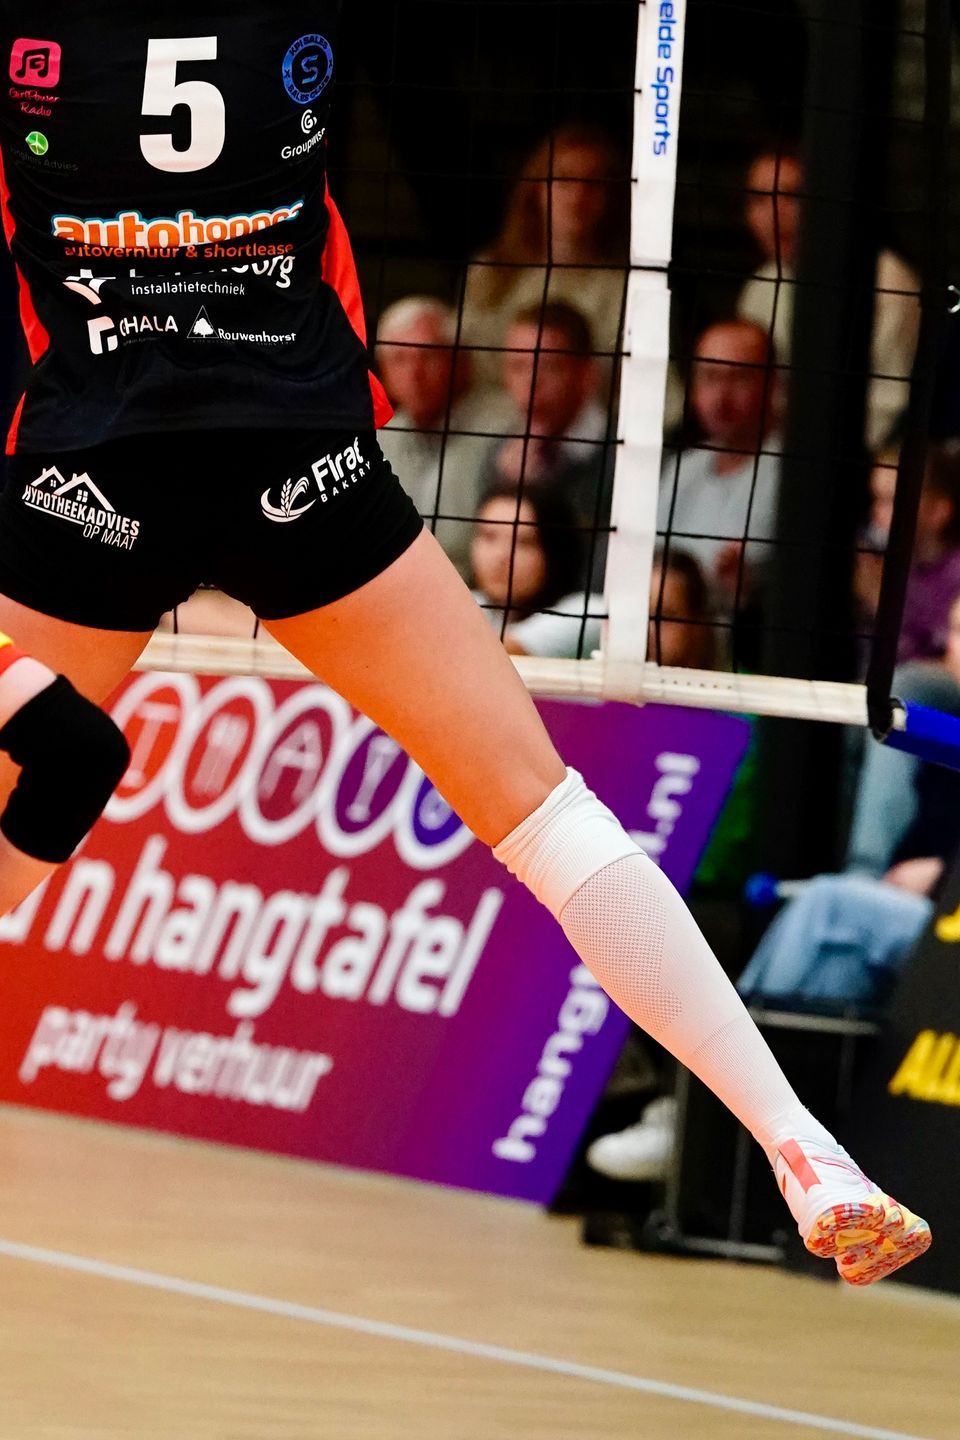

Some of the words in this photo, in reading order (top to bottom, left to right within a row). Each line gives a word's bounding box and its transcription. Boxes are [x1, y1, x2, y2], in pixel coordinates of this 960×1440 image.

[20, 101, 52, 117] Radio
[138, 36, 227, 173] 5
[650, 66, 675, 156] Sports
[185, 245, 198, 258] &
[204, 242, 295, 259] shortlease
[131, 280, 246, 296] installatietechniek
[217, 327, 297, 343] Rouwenhorst
[321, 460, 372, 503] BAKERY
[22, 484, 140, 537] HYPOTHEEKADVIES
[83, 522, 100, 539] OP
[100, 528, 138, 551] MAAT
[103, 833, 505, 1018] hangtafel
[18, 1000, 162, 1101] party
[152, 1018, 334, 1114] verhuur
